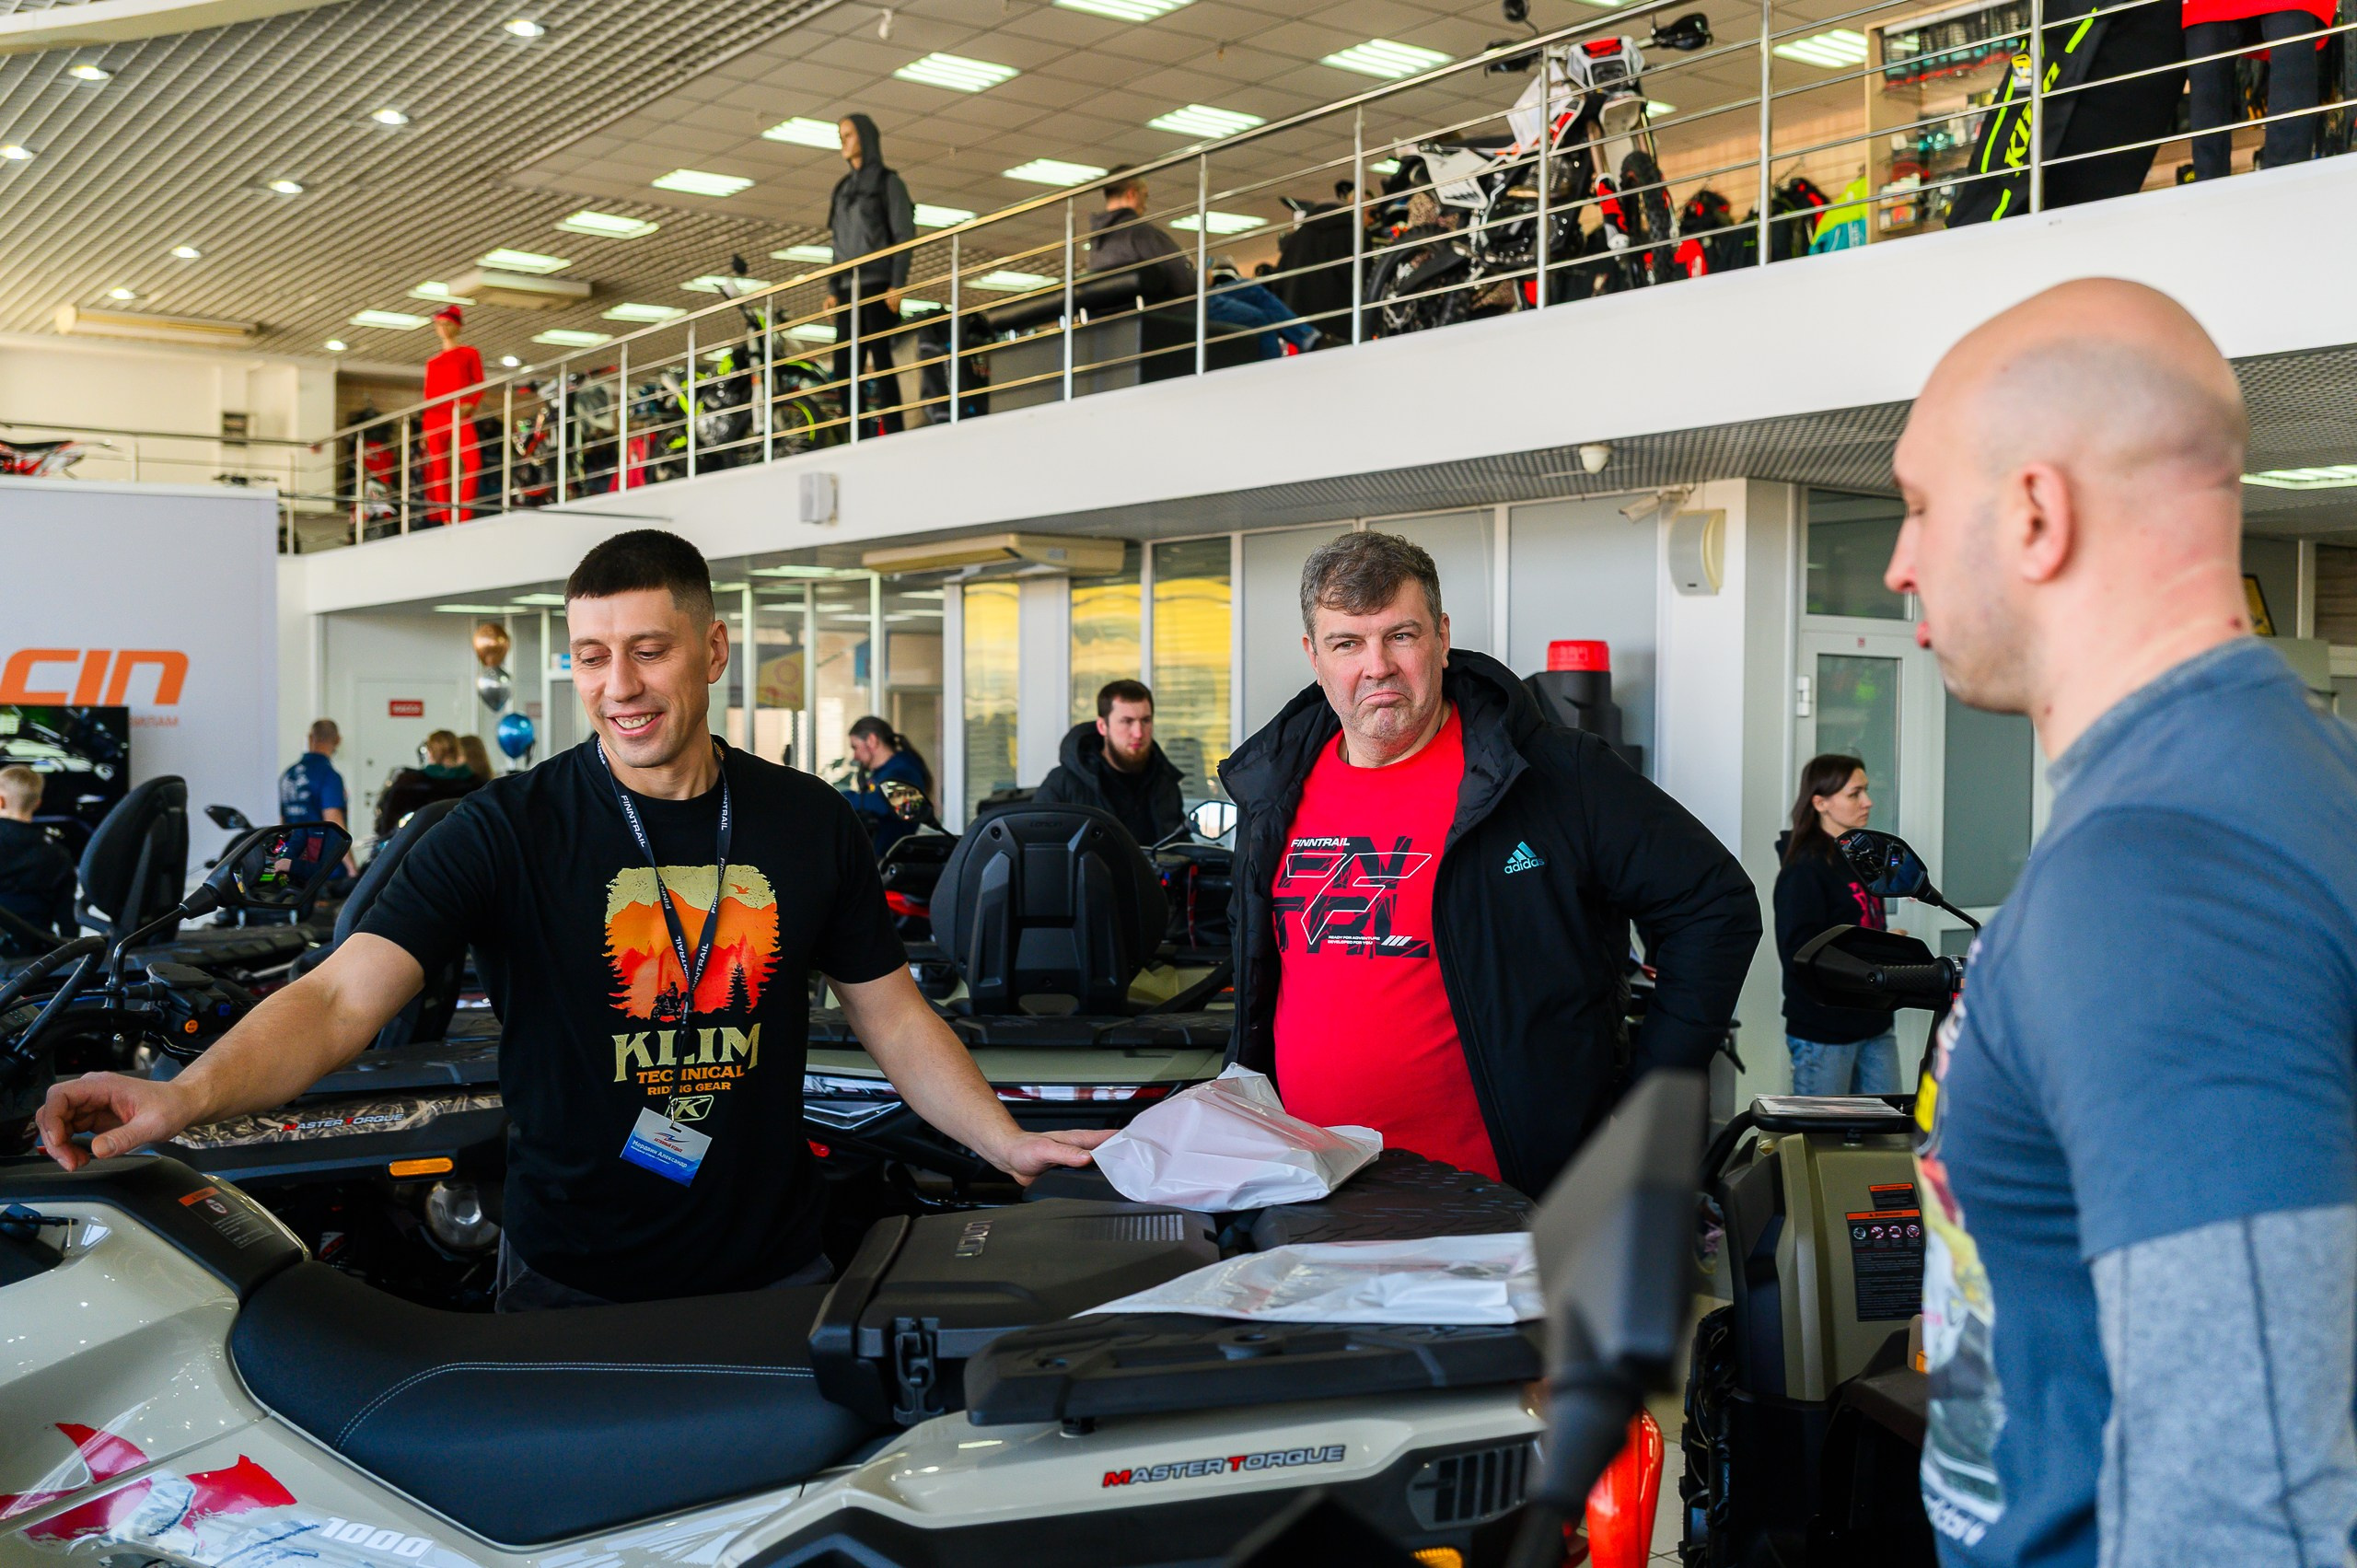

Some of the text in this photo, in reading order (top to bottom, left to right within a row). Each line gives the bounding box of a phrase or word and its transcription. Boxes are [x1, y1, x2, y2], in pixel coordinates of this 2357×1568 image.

[621, 795, 646, 848] FINNTRAIL
[1291, 838, 1350, 847] FINNTRAIL
[1504, 858, 1545, 874] adidas
[611, 1023, 761, 1083] KLIM
[636, 1065, 745, 1084] TECNICAL
[647, 1082, 731, 1096] RIDG GEAR
[657, 1149, 688, 1168] Александр
[320, 1516, 435, 1558] 1000
